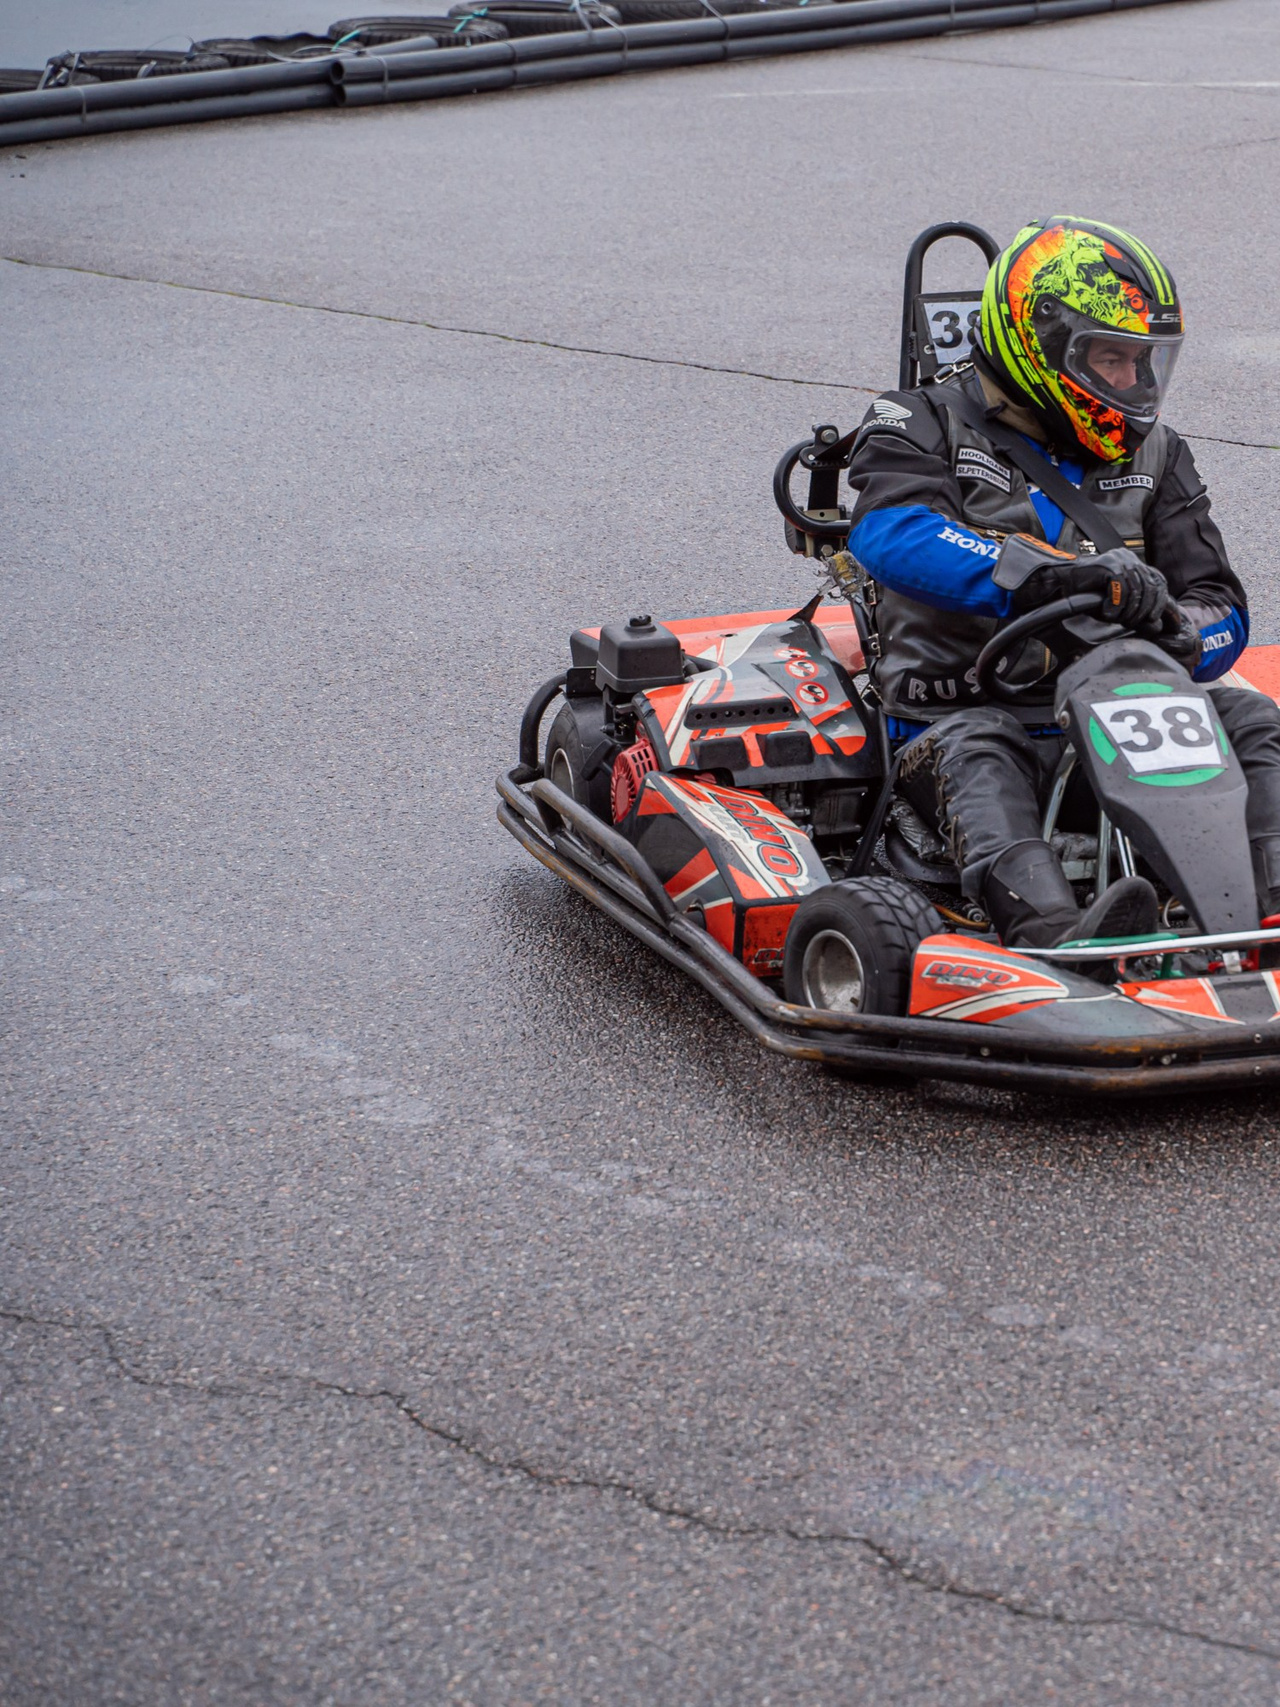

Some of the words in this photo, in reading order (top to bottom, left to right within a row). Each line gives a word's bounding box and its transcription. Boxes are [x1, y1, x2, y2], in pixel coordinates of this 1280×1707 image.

[960, 451, 1009, 476] HOOLIGANS
[1102, 476, 1151, 489] MEMBER
[1202, 629, 1234, 652] ONDA
[1109, 705, 1214, 753] 38
[708, 792, 803, 878] DINO
[926, 962, 1013, 984] DINO
